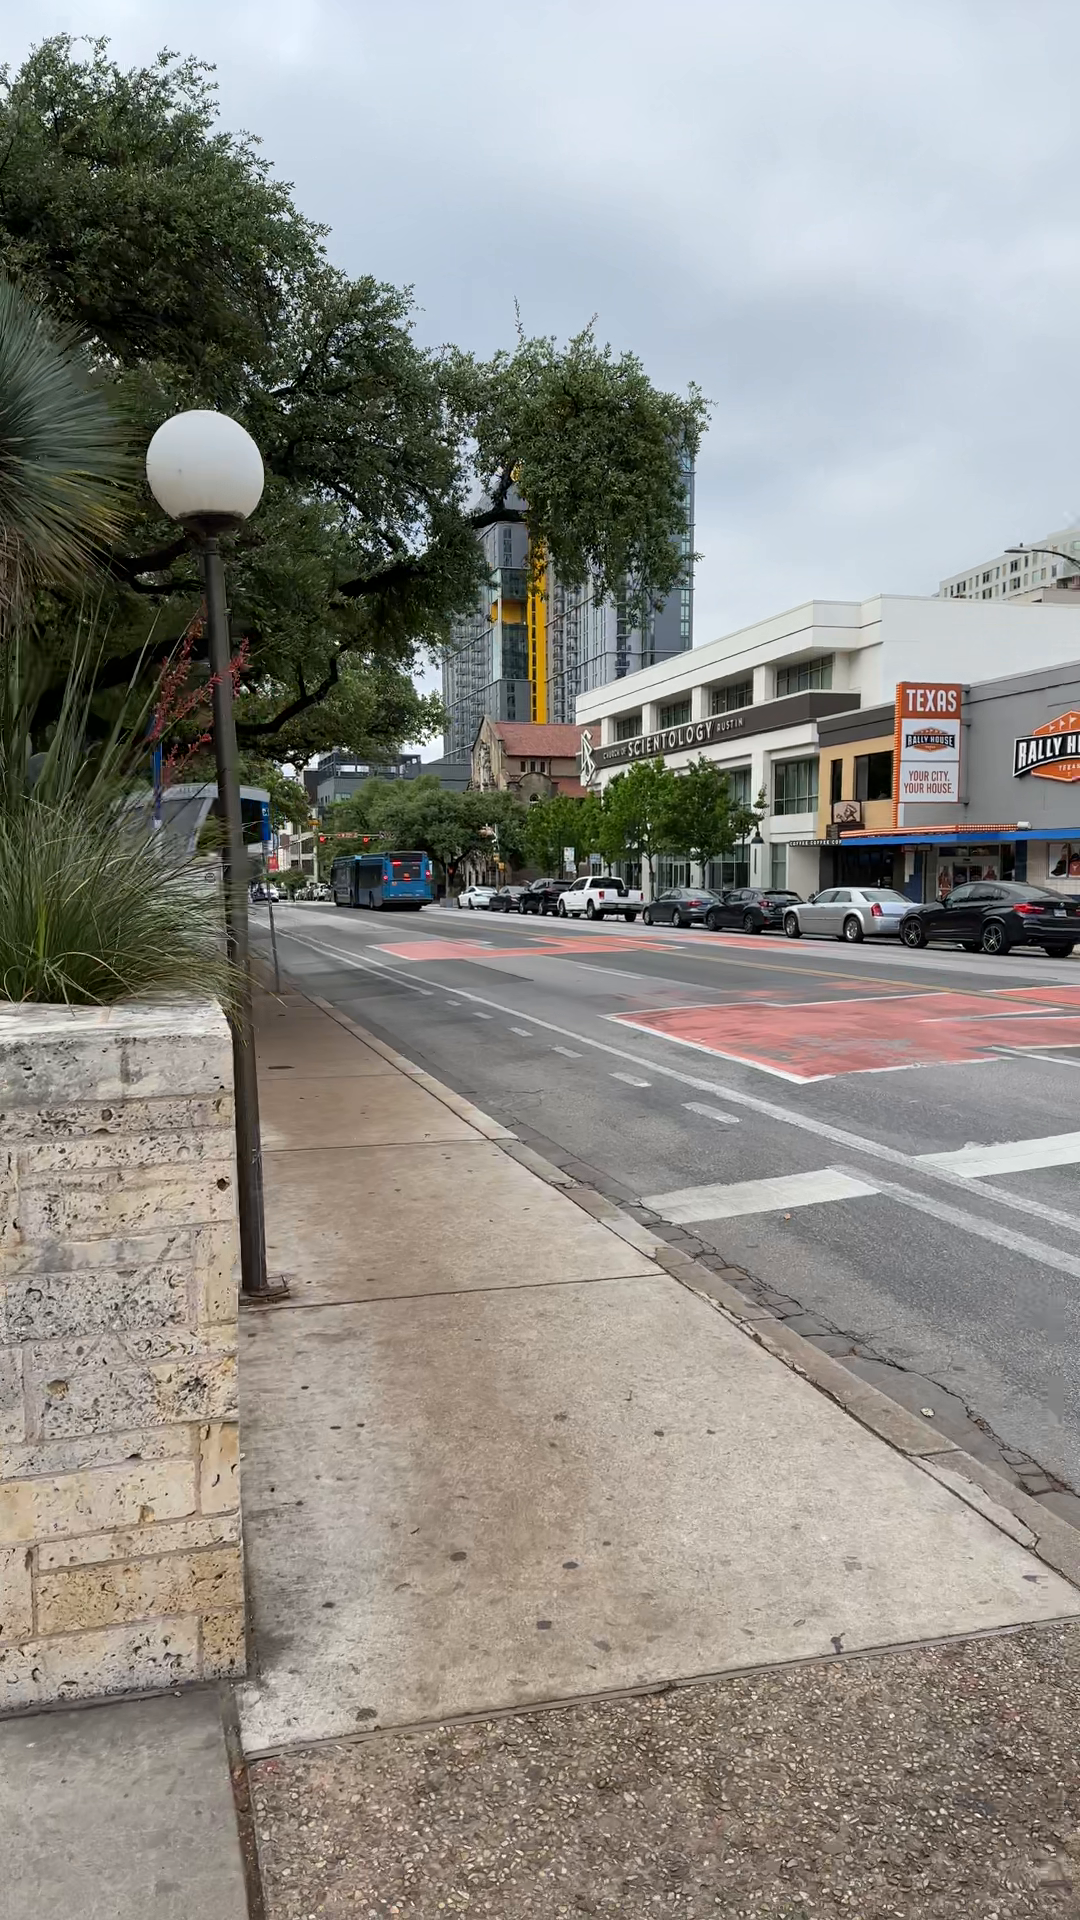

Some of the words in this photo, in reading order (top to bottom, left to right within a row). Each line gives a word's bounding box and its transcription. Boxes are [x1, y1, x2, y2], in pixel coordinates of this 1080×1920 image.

[906, 689, 957, 712] TEXAS
[603, 749, 620, 760] CHURCH
[621, 746, 627, 756] OF
[628, 721, 713, 757] SCIENTOLOGY
[717, 717, 743, 732] AUSTIN
[907, 735, 929, 745] RALLY
[930, 735, 953, 747] HOUSE
[1018, 737, 1062, 769] RALLY
[908, 770, 929, 781] YOUR
[931, 770, 950, 782] CITY.
[903, 783, 924, 794] YOUR
[926, 783, 954, 794] HOUSE.
